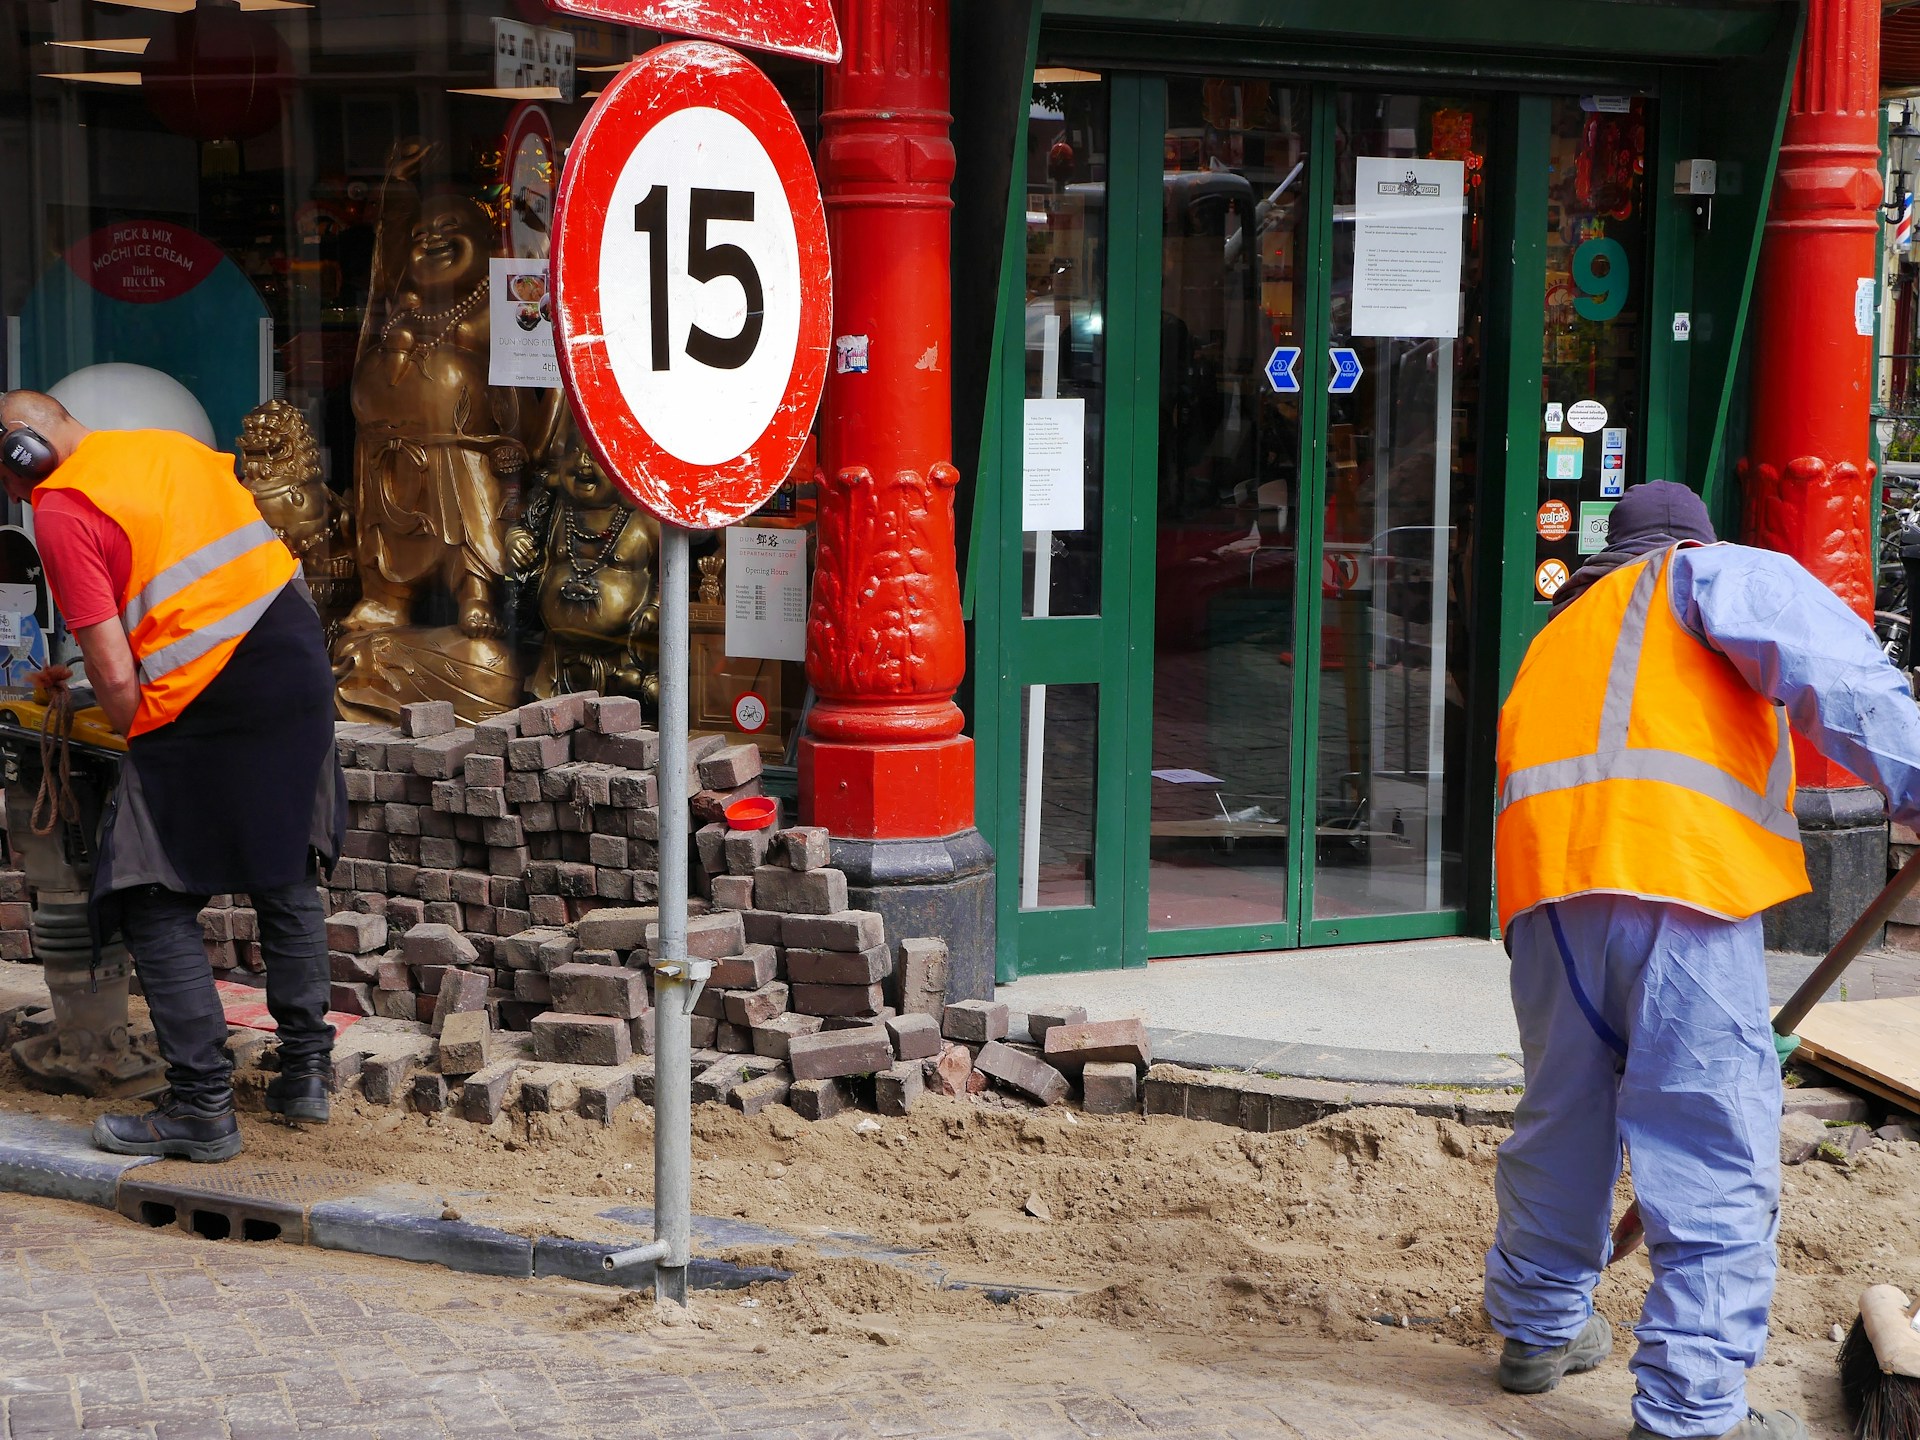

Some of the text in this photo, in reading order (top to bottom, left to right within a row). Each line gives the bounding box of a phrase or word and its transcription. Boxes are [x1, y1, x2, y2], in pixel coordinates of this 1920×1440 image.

[113, 228, 172, 244] PICK & MIX
[92, 245, 194, 272] MOCHI ICE CREAM
[133, 265, 154, 276] little
[634, 184, 764, 372] 15
[1572, 236, 1630, 321] 9
[542, 363, 557, 372] 4th
[1541, 512, 1560, 524] yelp
[745, 567, 769, 576] Opening
